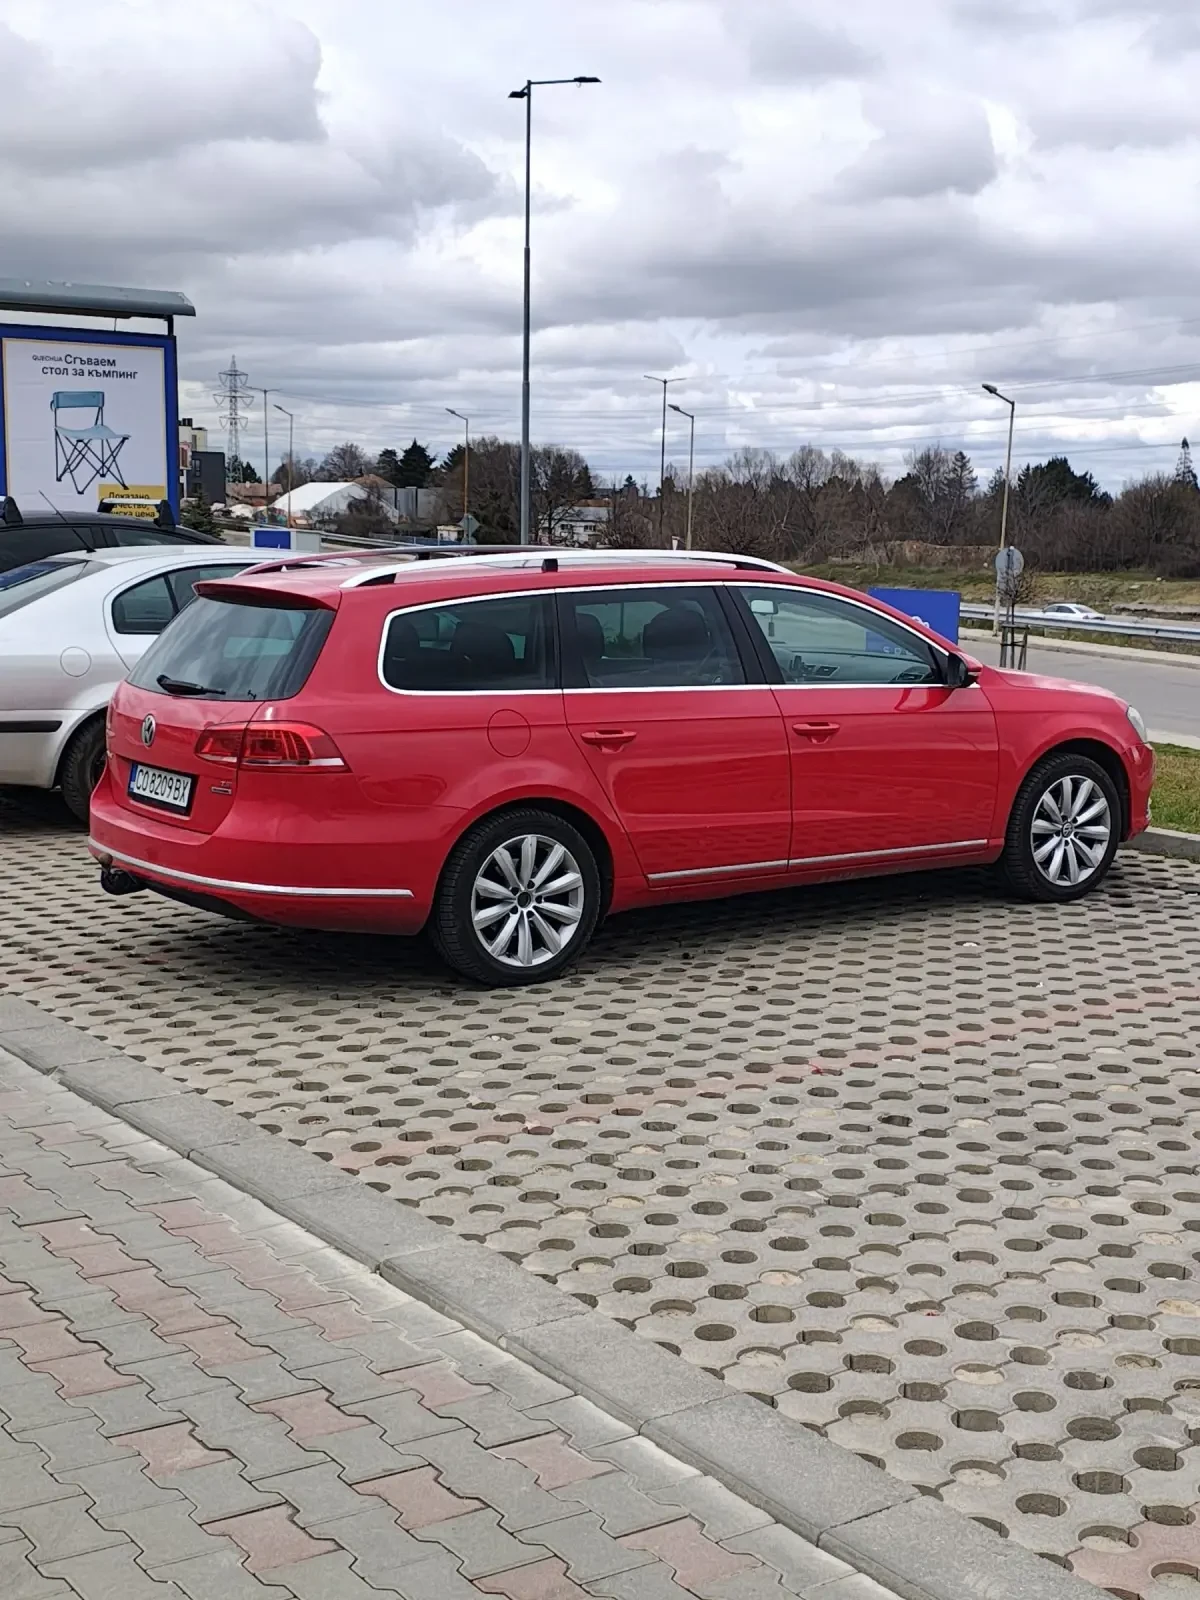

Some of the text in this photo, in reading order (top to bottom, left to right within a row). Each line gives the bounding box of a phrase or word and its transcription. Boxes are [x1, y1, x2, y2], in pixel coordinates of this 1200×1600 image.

[64, 353, 116, 367] Сгъваем
[41, 366, 138, 380] стол за къмпинг
